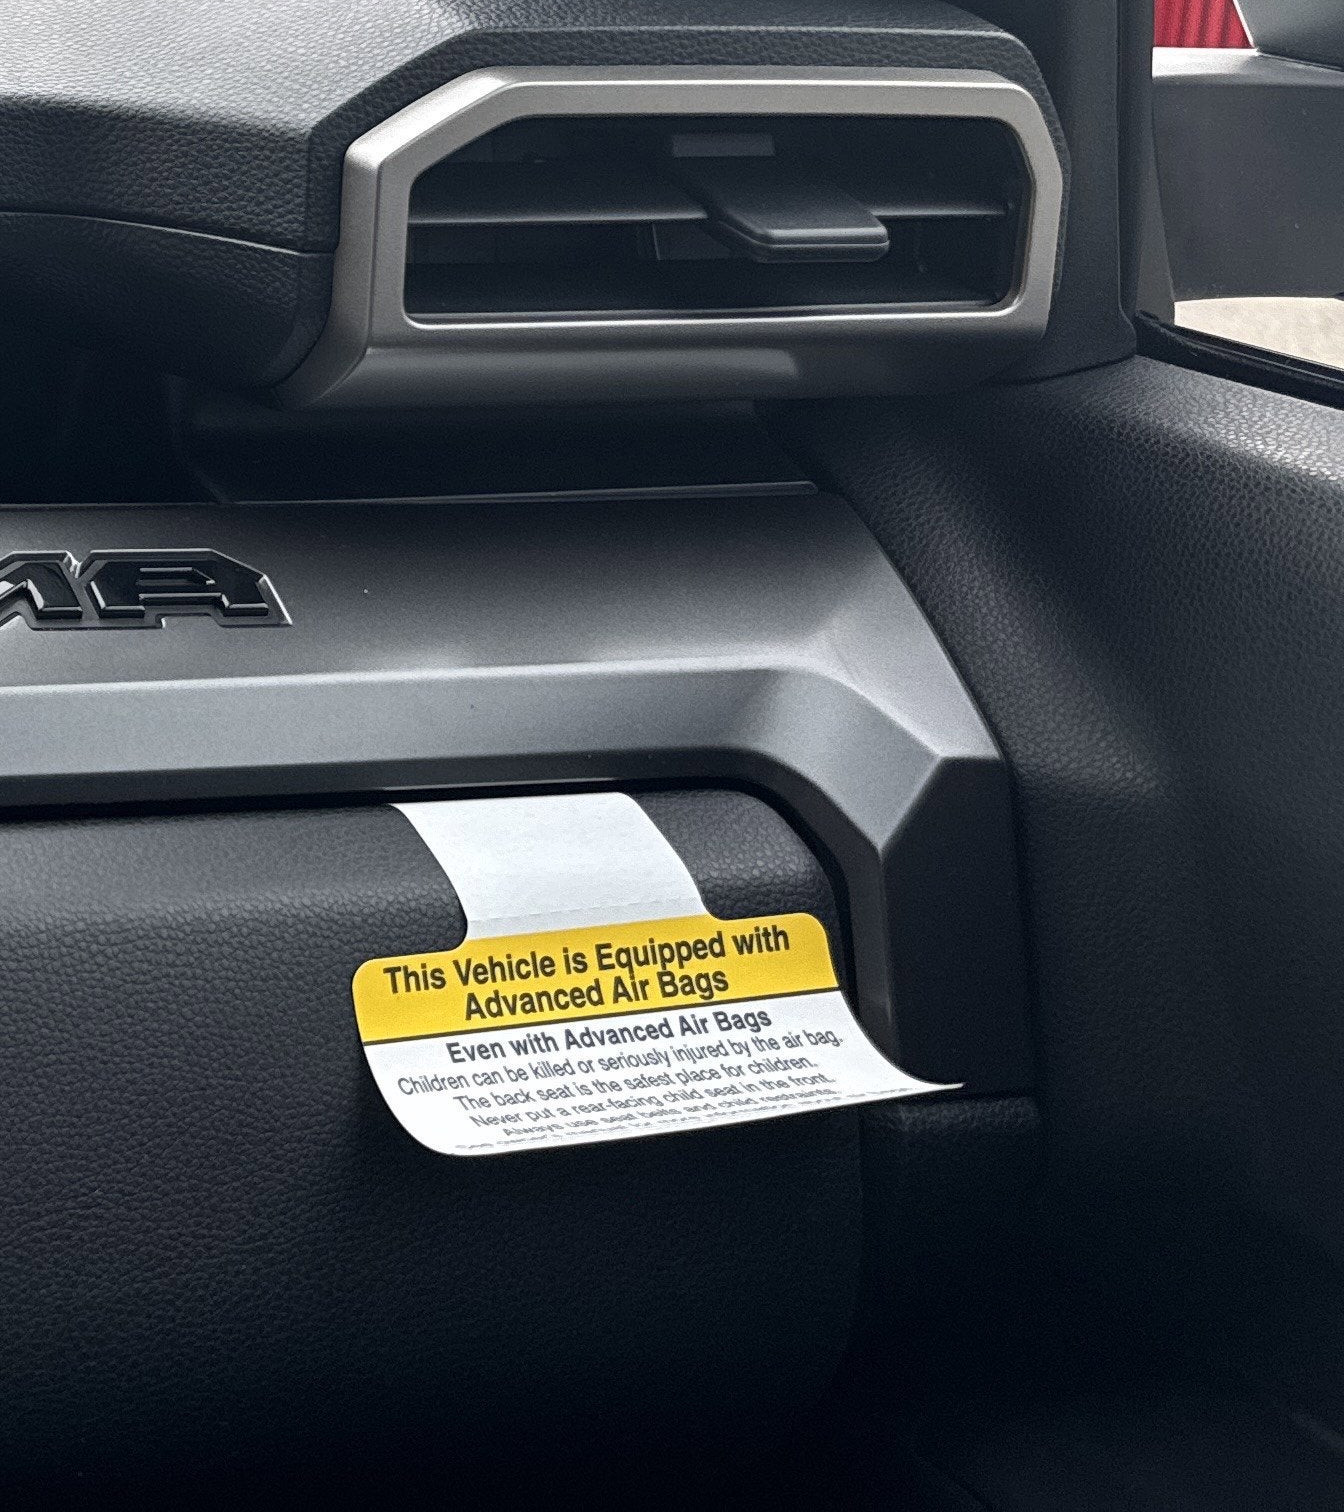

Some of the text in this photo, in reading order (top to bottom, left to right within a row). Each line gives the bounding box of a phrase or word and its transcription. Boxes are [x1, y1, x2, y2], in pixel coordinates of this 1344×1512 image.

[383, 924, 790, 994] This Vehicle is Equipped with
[465, 969, 730, 1021] Advanced Air Bags
[397, 1028, 844, 1096] Children can be killed or seriously injured by the air bag.
[445, 1010, 773, 1064] Even with Advanced Air Bags
[453, 1055, 818, 1112] The back seat is the safest place for children.
[468, 1112, 524, 1128] Never
[525, 1106, 556, 1124] put
[555, 1105, 573, 1118] a
[572, 1093, 664, 1115] rear-facing
[662, 1088, 705, 1104] child
[704, 1083, 742, 1099] seat
[741, 1080, 762, 1093] in
[760, 1077, 789, 1091] the
[787, 1070, 838, 1087] front.
